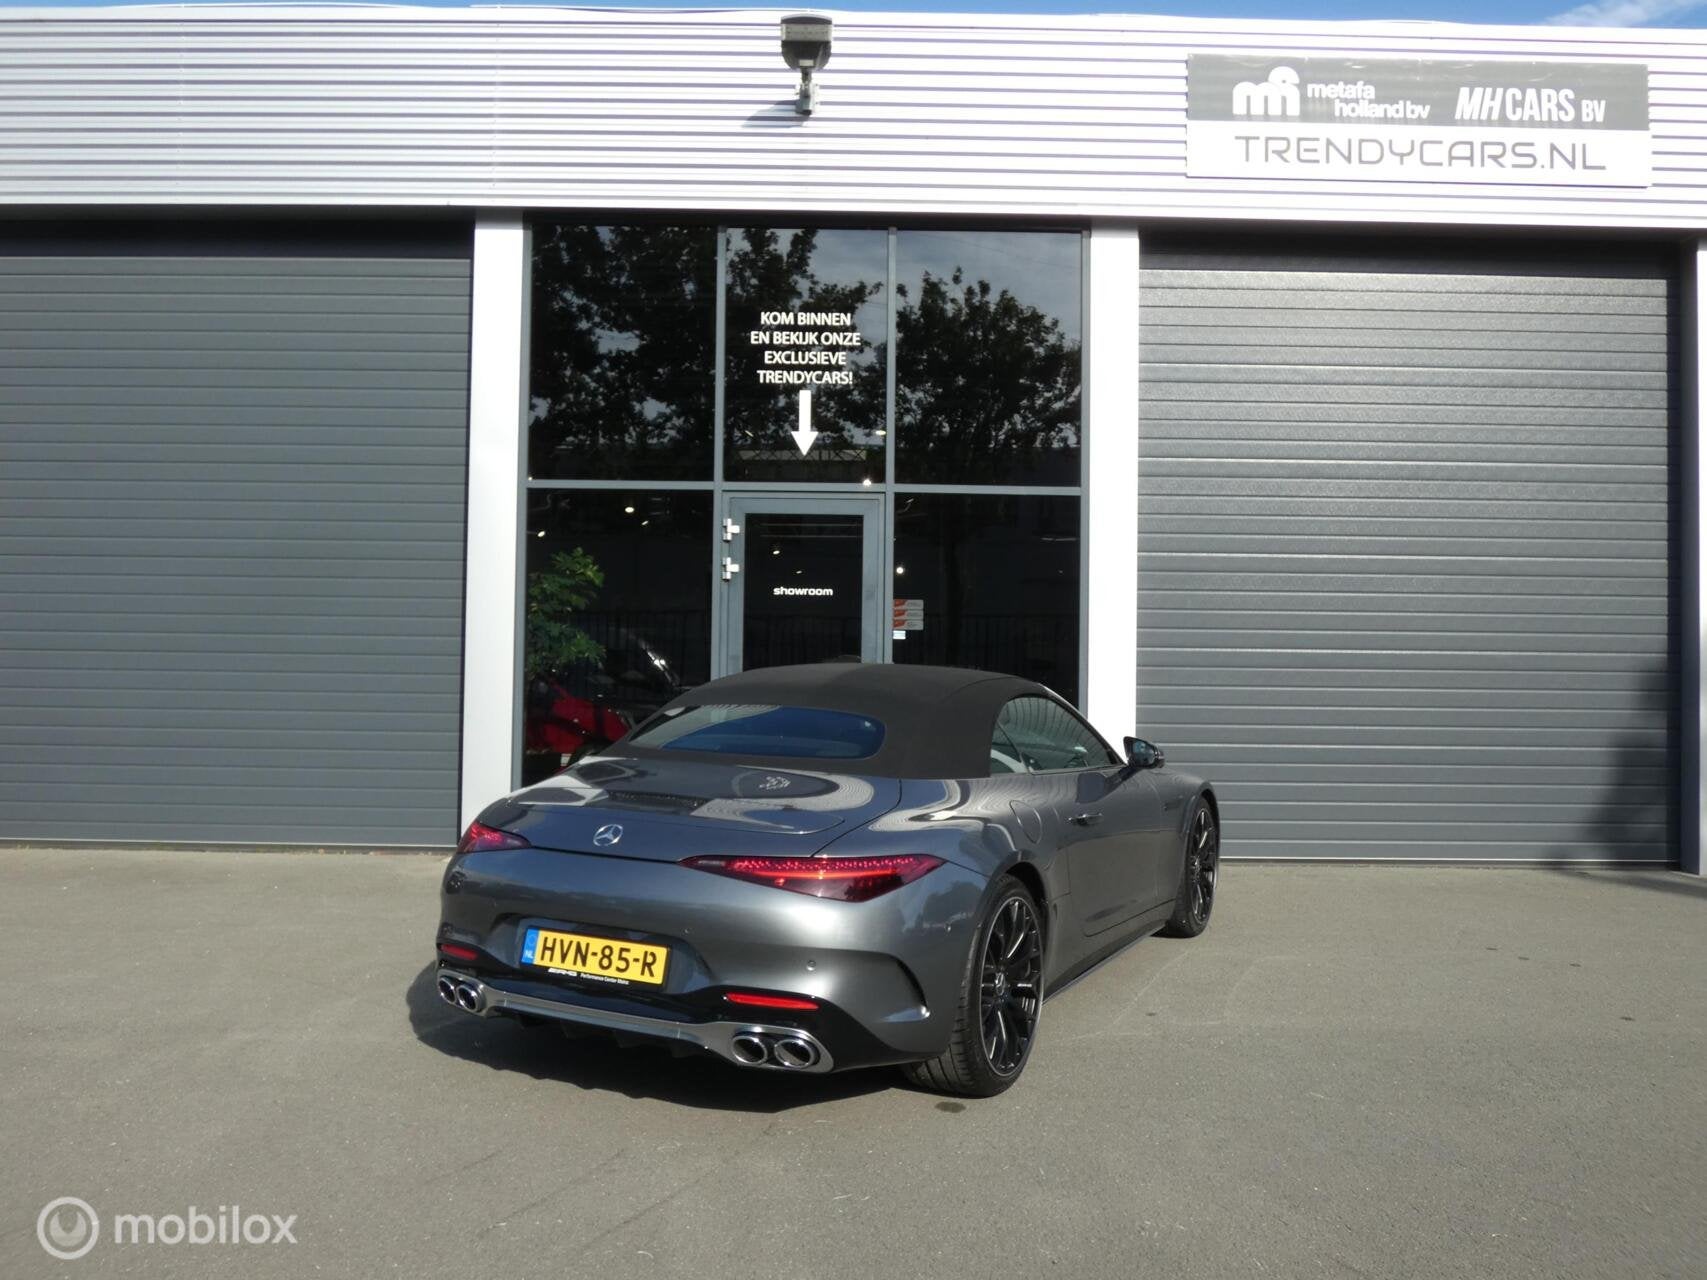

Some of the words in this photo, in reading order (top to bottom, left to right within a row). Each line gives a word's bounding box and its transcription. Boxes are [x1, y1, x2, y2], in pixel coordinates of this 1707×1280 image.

[1307, 81, 1376, 99] metafa
[1334, 99, 1404, 118] holland
[1406, 101, 1431, 119] bv
[1582, 100, 1606, 123] BV
[1234, 135, 1607, 171] TRENDYCARS.NL
[760, 311, 795, 326] KOM
[797, 312, 851, 326] BINNEN
[750, 330, 770, 345] EN
[772, 331, 819, 345] BEKIJK
[820, 331, 861, 346] ONZE
[764, 350, 847, 365] EXCLUSIEVE
[757, 369, 853, 385] TRENDYCARS!
[773, 586, 834, 596] showroom
[540, 936, 658, 978] HVN-85-R
